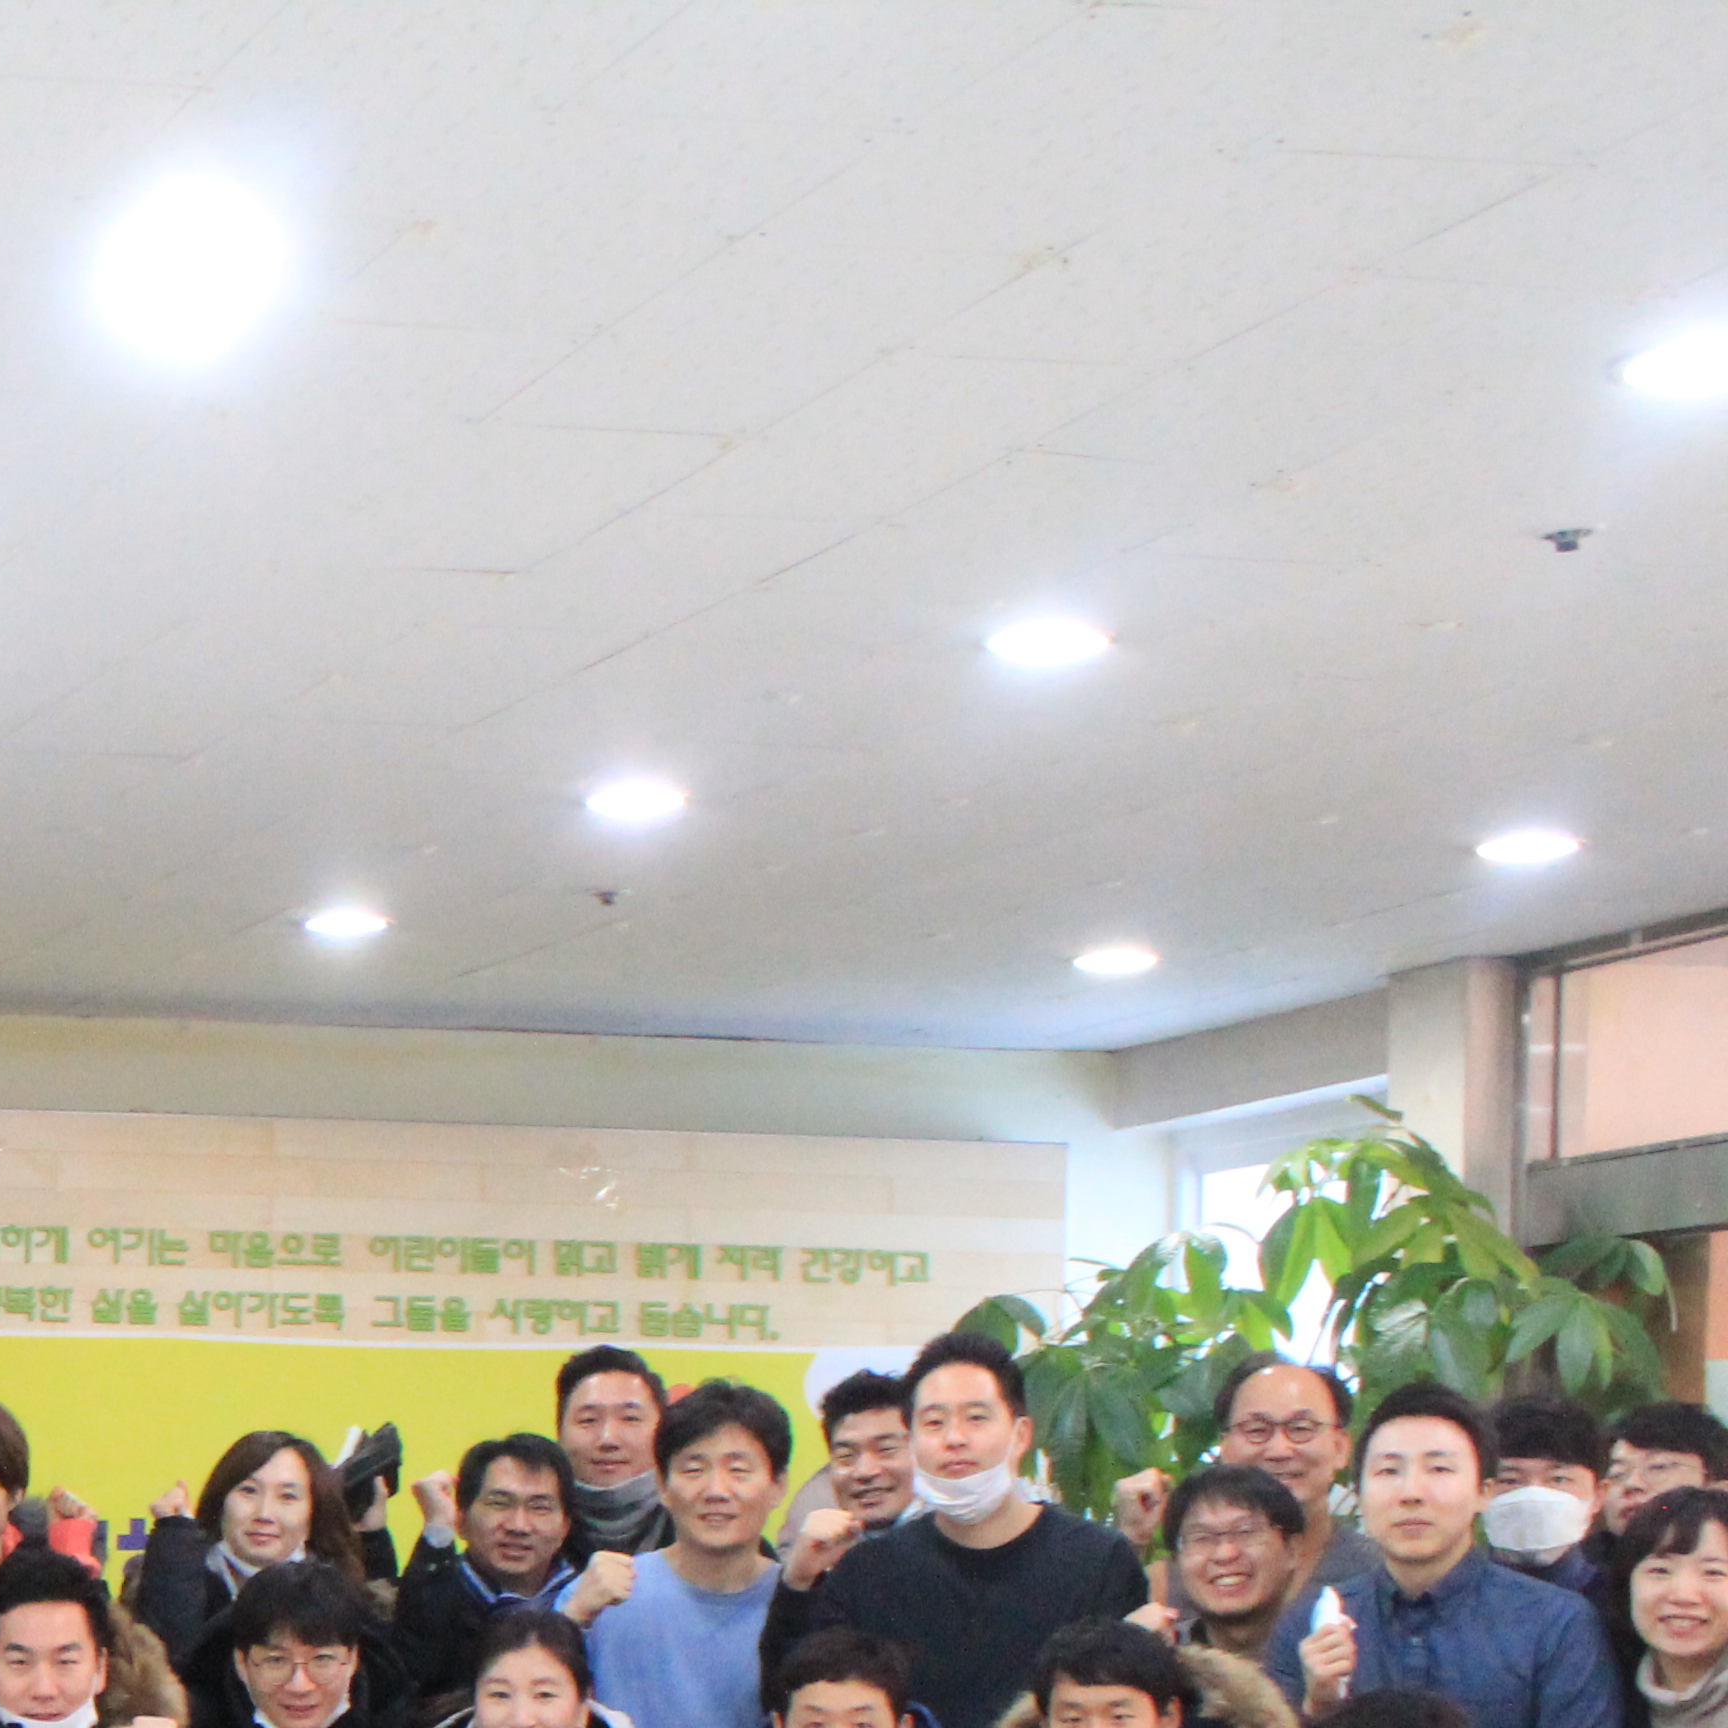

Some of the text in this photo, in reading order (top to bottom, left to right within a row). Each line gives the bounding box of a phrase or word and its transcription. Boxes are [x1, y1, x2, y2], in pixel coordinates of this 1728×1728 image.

[87, 1225, 190, 1267] 여기는
[208, 1229, 343, 1269] 마음으로
[368, 1234, 537, 1276] 어린이들이
[553, 1239, 619, 1278] 맑고
[635, 1241, 703, 1281] 밝게
[716, 1243, 785, 1282] 자라
[800, 1246, 931, 1286] 건강하고
[90, 1287, 159, 1326] 삶을
[177, 1290, 347, 1331] 살아가도록
[372, 1294, 472, 1333] 그들을
[488, 1297, 621, 1337] 사랑하고
